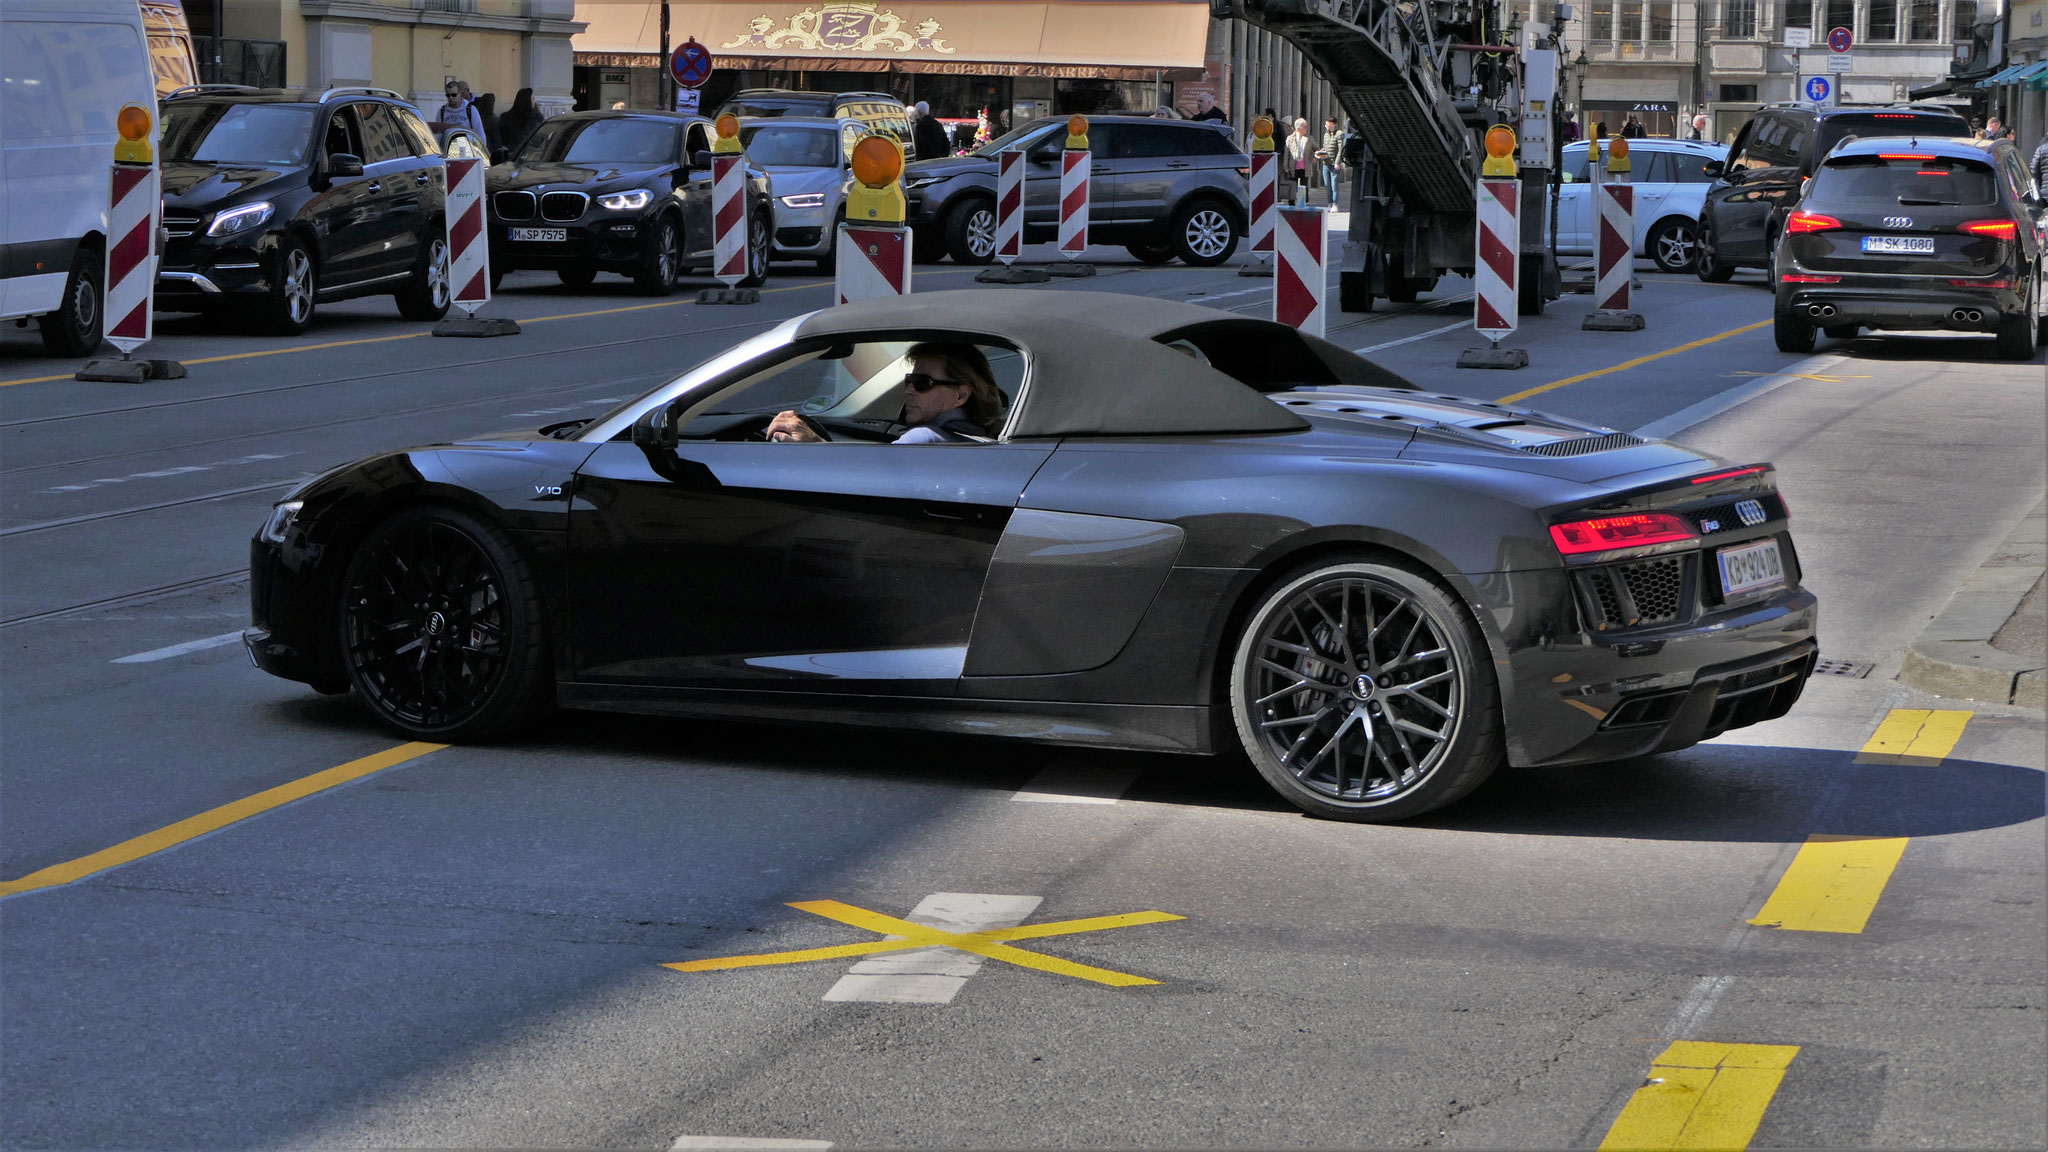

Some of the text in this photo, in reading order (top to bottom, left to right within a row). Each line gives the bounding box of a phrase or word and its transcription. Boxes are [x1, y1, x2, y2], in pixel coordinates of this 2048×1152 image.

[921, 62, 1109, 79] ZECHBAUER ZIGARREN
[605, 75, 626, 83] BMZ
[1633, 103, 1668, 112] ZARA
[514, 229, 565, 240] M SP 7575
[1869, 237, 1933, 251] M SK 1080
[1725, 546, 1780, 587] KB 924 DB
